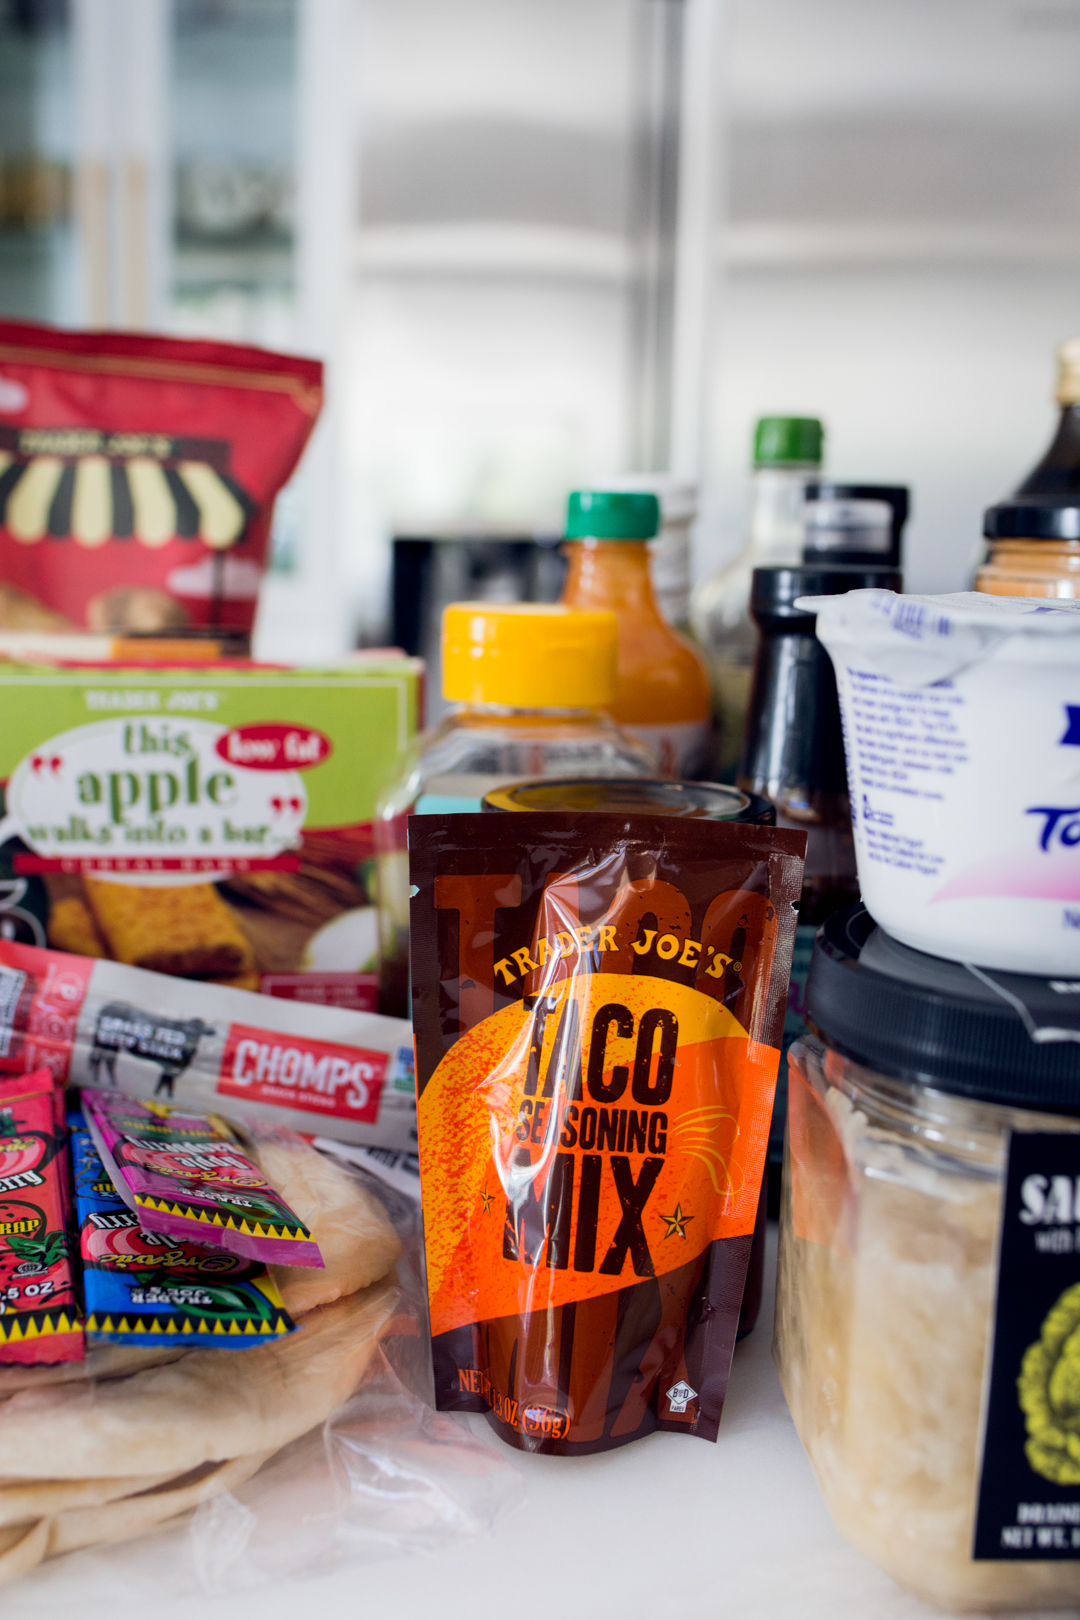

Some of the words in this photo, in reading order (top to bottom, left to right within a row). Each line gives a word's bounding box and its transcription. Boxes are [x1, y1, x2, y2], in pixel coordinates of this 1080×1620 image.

[123, 722, 191, 757] this
[228, 735, 276, 760] low
[284, 732, 321, 760] fat
[77, 752, 238, 825] apple
[28, 814, 112, 845] walks
[124, 817, 187, 844] into
[199, 825, 213, 843] a
[493, 924, 620, 986] TRADER
[523, 995, 679, 1105] TACO
[233, 1039, 375, 1109] CHOMPS
[146, 1163, 267, 1187] Organic
[173, 1151, 252, 1171] Apple
[180, 1187, 252, 1208] TRADER
[502, 1147, 665, 1278] MIX
[99, 1250, 238, 1273] Organic
[25, 1281, 53, 1297] OZ
[131, 1292, 213, 1304] TRADER
[458, 1368, 484, 1395] NET
[504, 1397, 519, 1427] OZ
[522, 1404, 571, 1440] (36g)
[1001, 1526, 1034, 1549] NET
